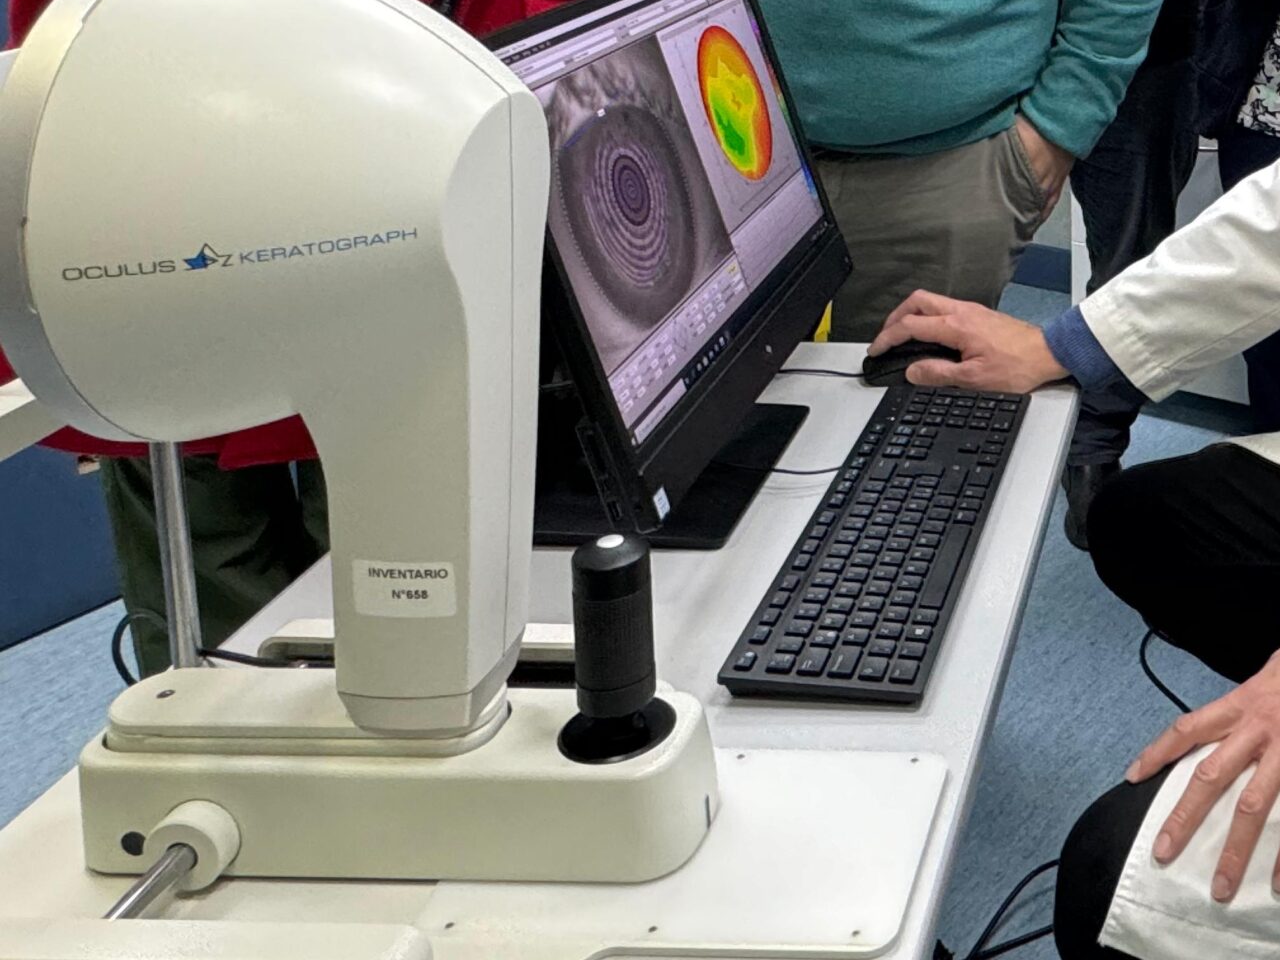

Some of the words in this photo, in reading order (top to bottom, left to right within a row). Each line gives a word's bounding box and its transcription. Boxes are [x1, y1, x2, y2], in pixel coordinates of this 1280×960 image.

[62, 259, 176, 281] OCULUS
[239, 227, 418, 265] KERATOGRAPH
[368, 567, 448, 579] INVENTARIO
